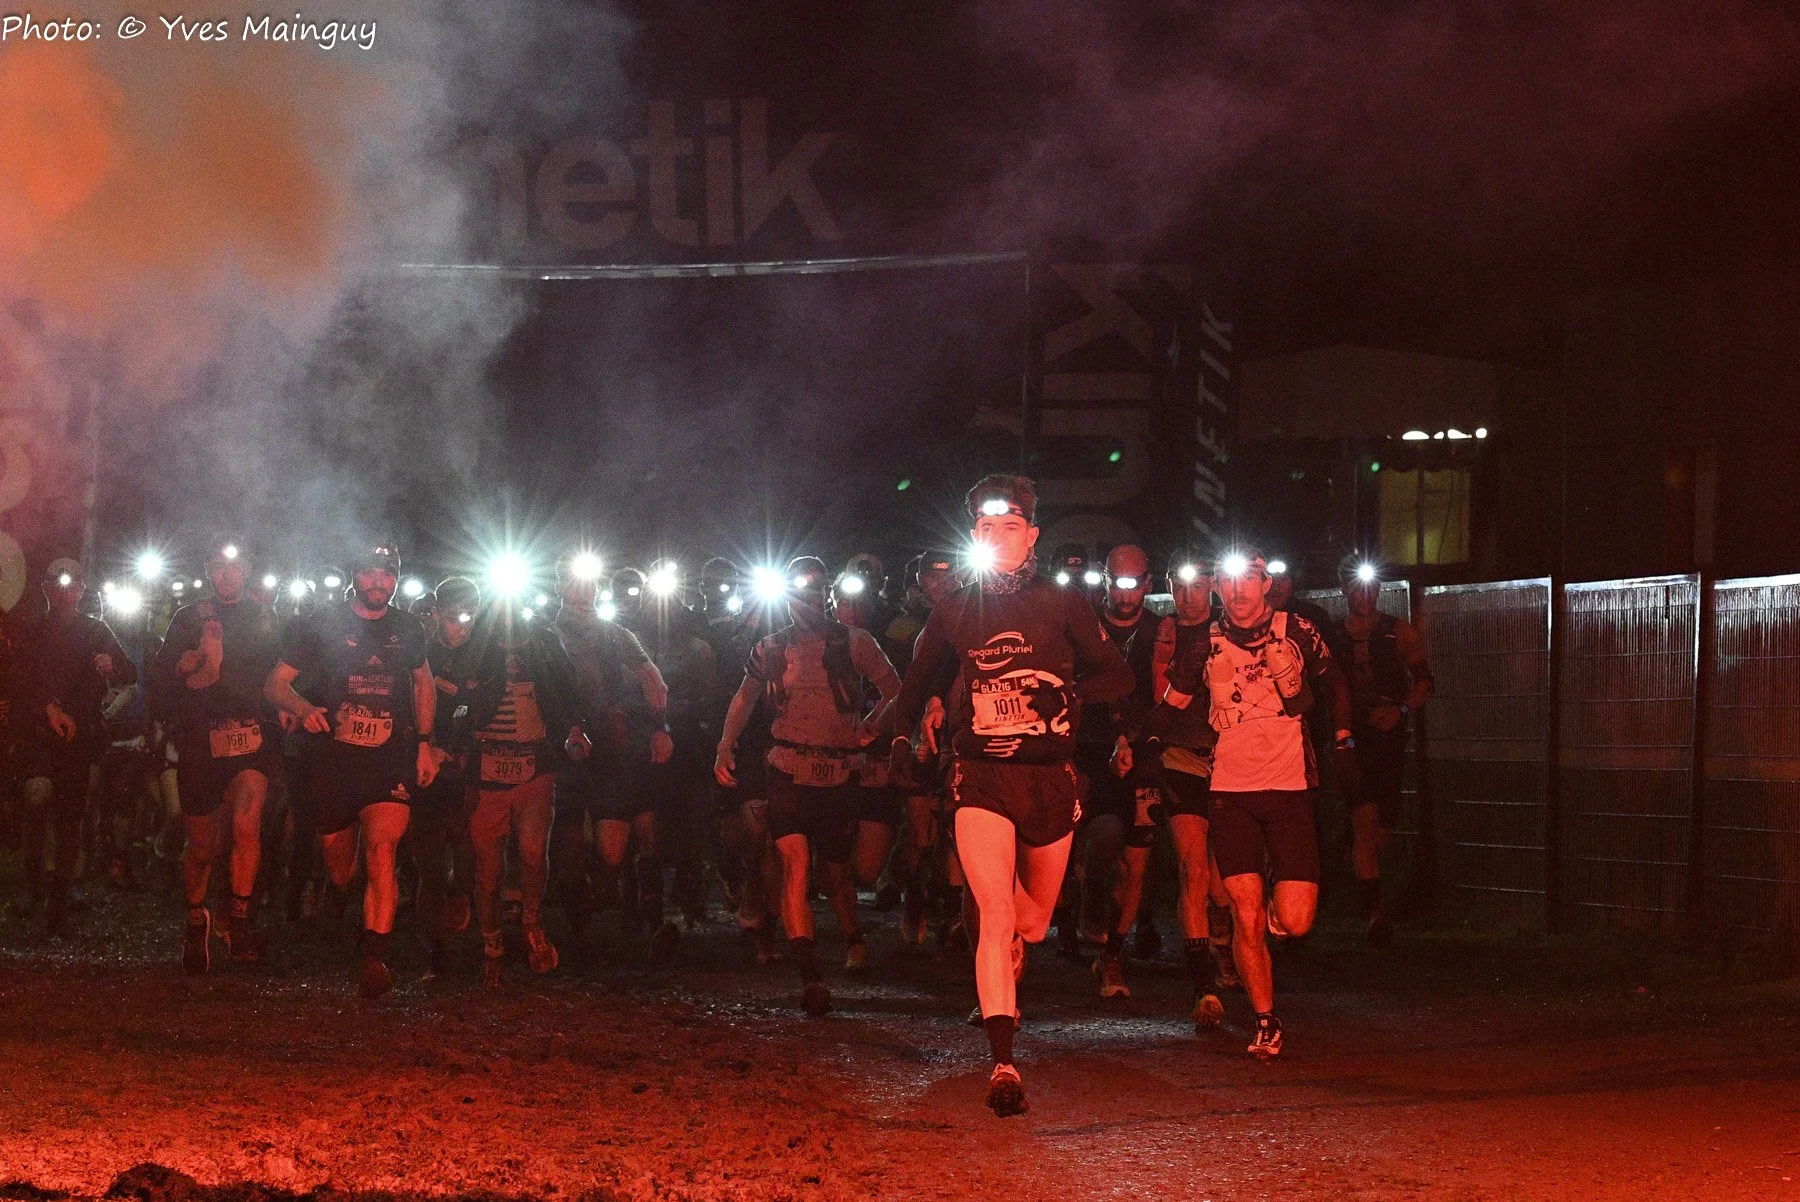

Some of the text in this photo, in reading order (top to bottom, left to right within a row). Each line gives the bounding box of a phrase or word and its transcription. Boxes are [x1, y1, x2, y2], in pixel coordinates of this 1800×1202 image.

[967, 644, 1033, 660] Regard Pluriel
[981, 681, 1011, 694] GLAZIG
[348, 707, 373, 718] GLAZIG
[993, 697, 1021, 716] 1011
[352, 721, 377, 737] 1841
[494, 760, 522, 775] 3079
[811, 763, 835, 777] 1001
